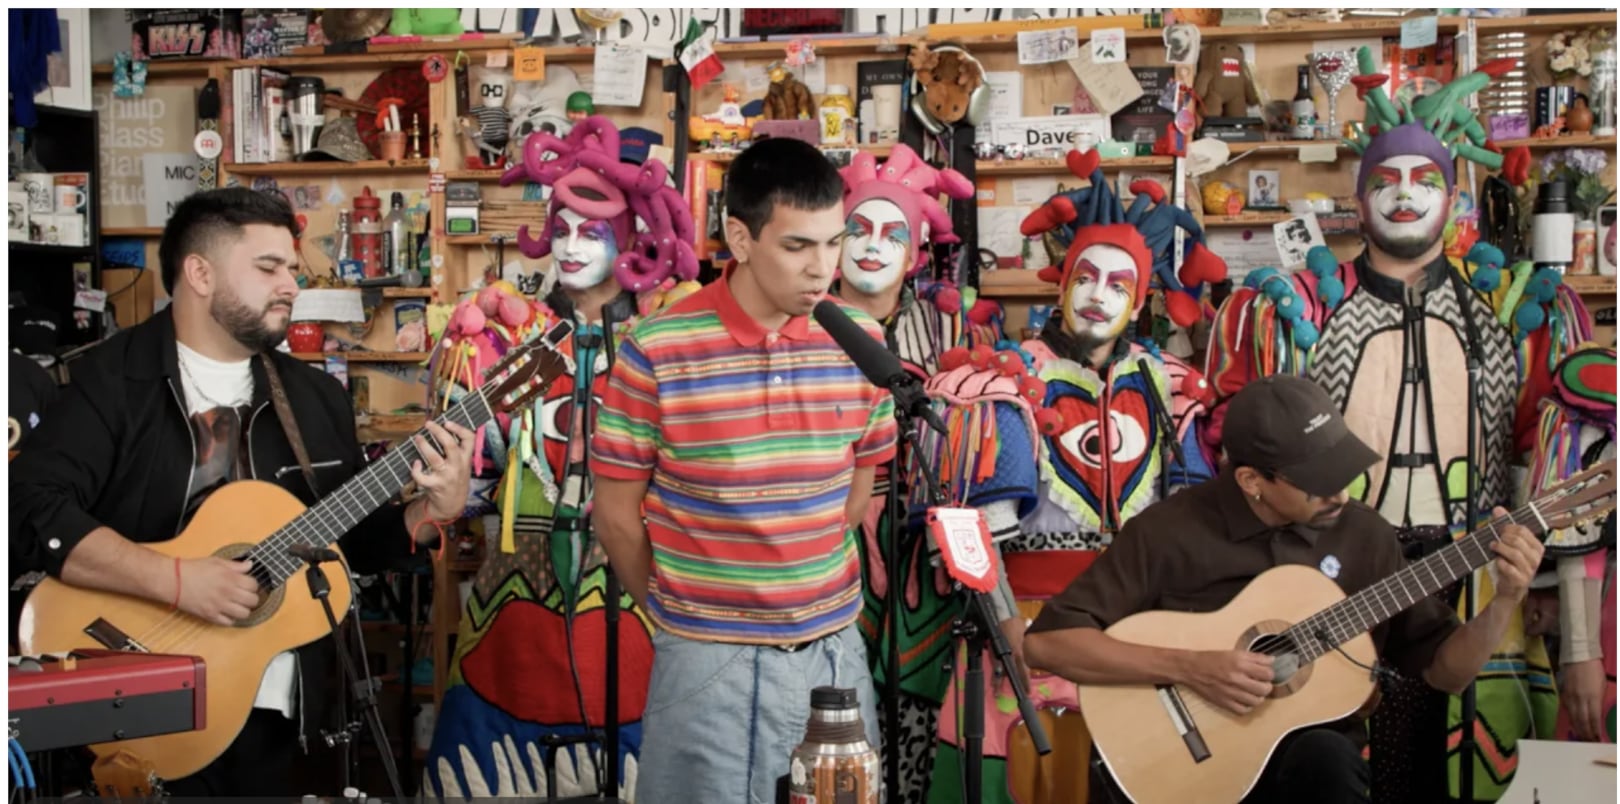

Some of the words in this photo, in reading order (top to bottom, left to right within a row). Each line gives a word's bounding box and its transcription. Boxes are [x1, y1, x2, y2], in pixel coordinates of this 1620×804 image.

[148, 23, 206, 56] KISS
[1026, 129, 1075, 145] Dave
[165, 165, 195, 180] MIC
